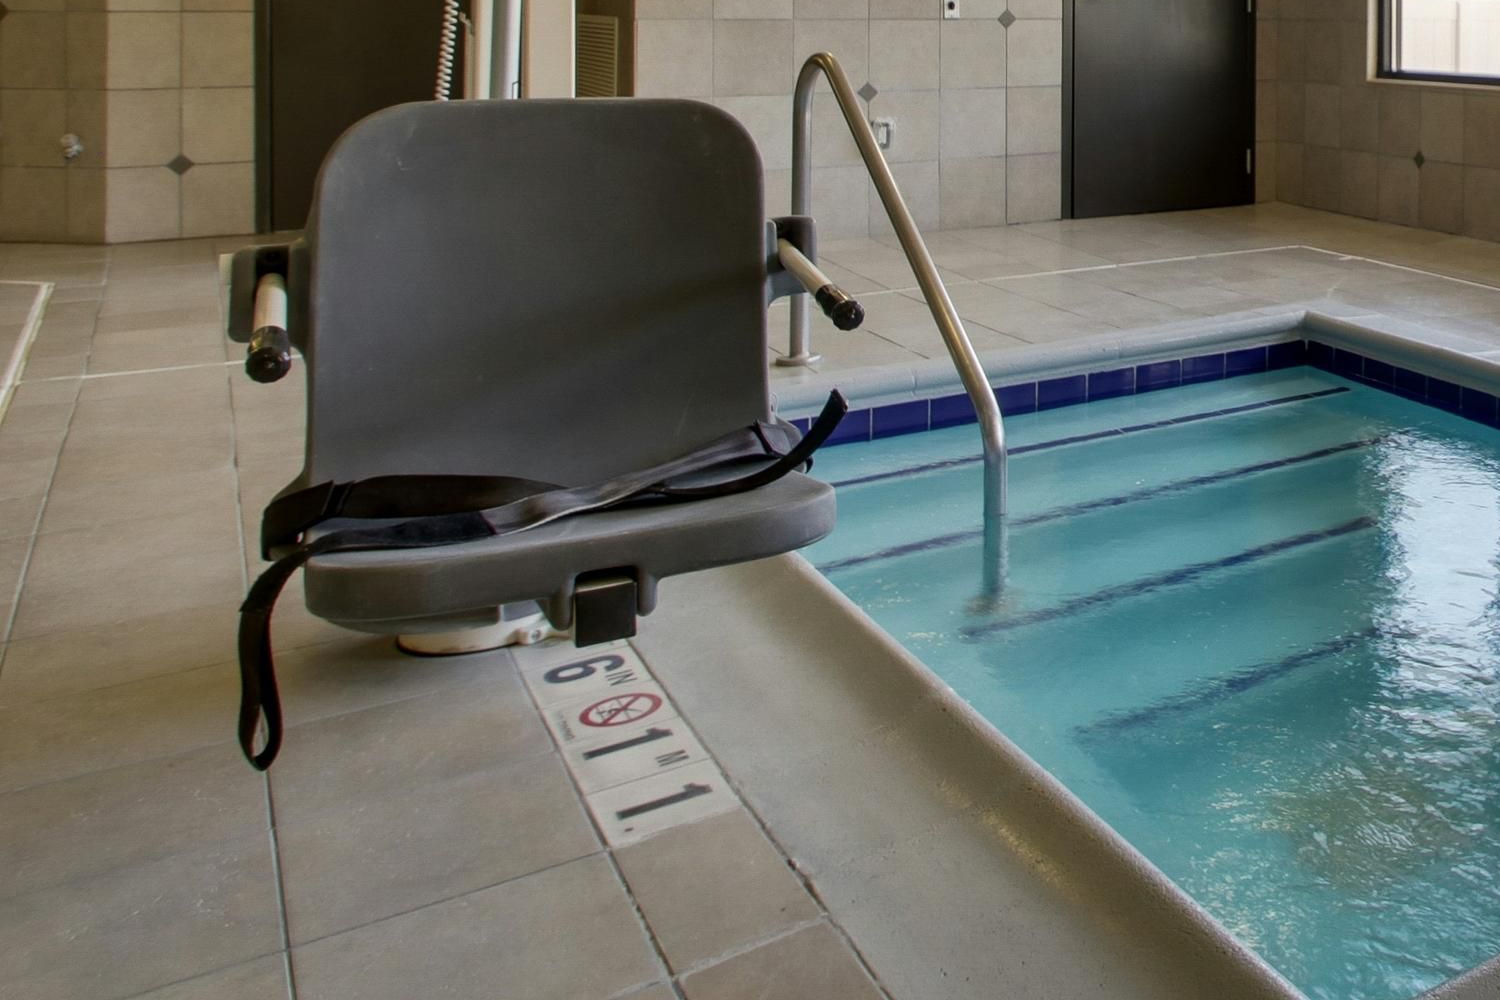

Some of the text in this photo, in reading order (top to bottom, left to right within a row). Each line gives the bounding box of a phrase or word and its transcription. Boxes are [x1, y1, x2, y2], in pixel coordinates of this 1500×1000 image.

[543, 654, 637, 687] 6 IN
[582, 727, 689, 768] 1 M
